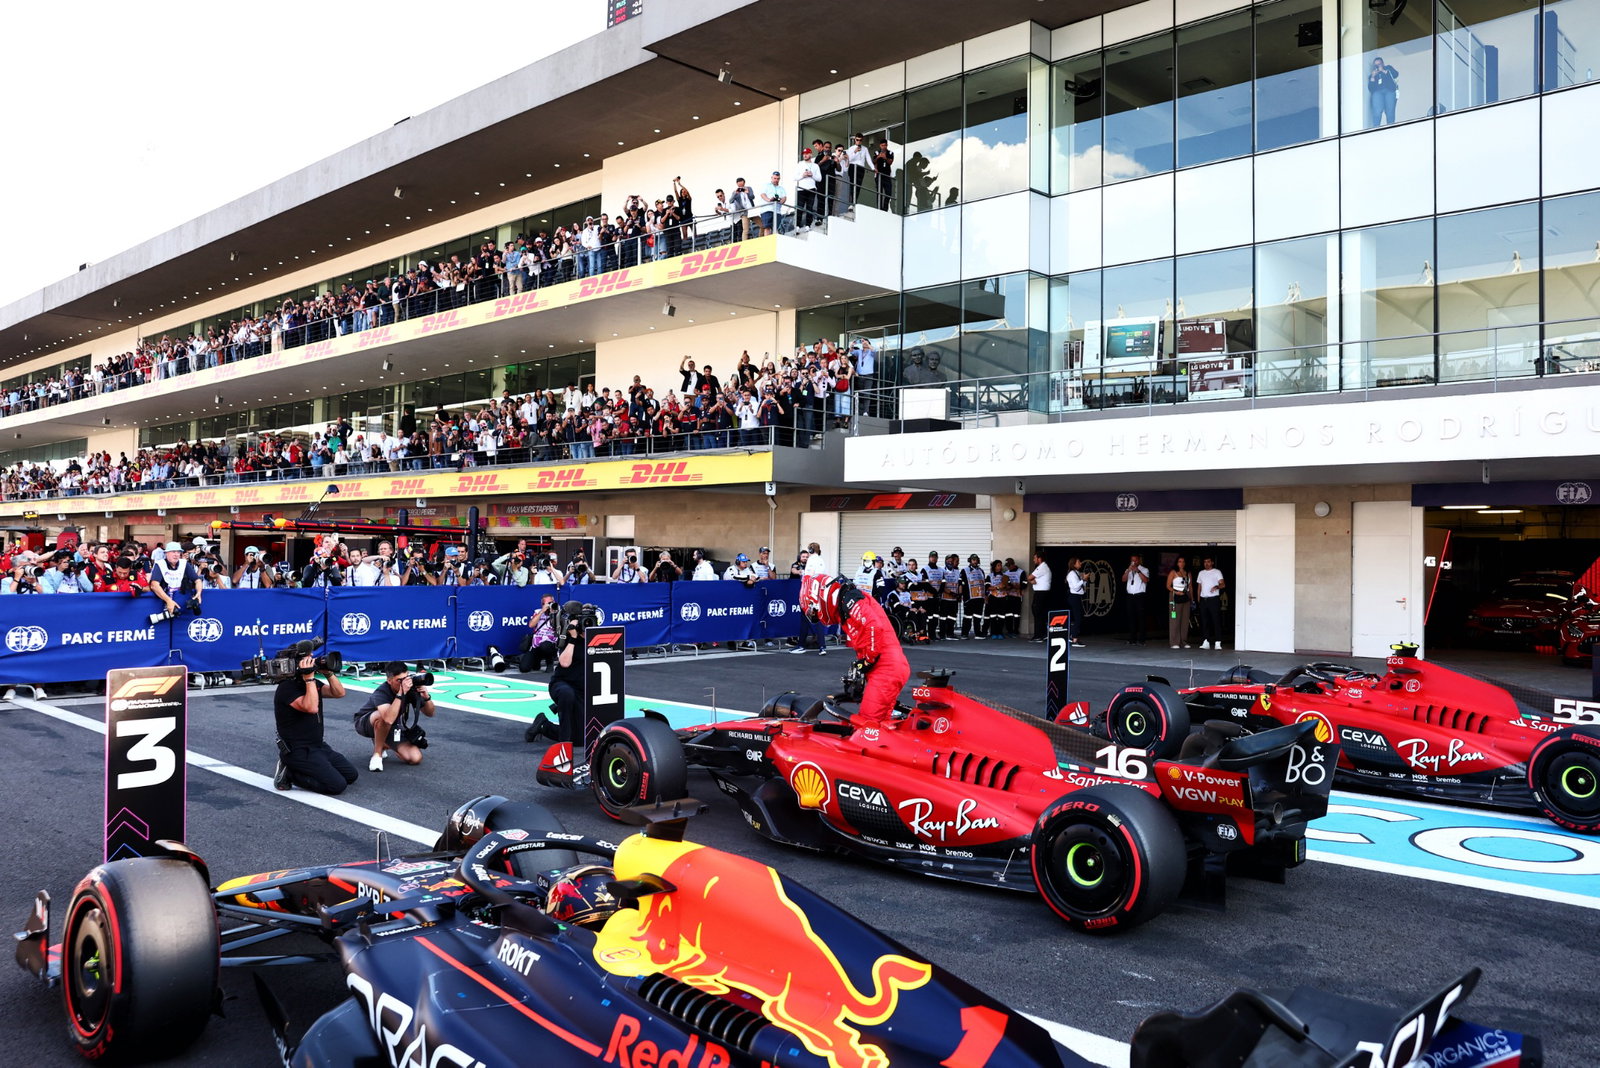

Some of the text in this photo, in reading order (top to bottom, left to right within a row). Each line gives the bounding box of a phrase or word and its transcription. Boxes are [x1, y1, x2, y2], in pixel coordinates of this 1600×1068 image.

[680, 245, 746, 277] DHL
[579, 270, 632, 298] DHL
[494, 292, 539, 317] DHL
[421, 310, 460, 333] DHL
[359, 327, 392, 348] DHL
[304, 341, 334, 360] DHL
[881, 440, 1084, 467] AUTÓDROMO
[1109, 424, 1334, 456] HERMANOS
[536, 468, 588, 490] DHL
[630, 462, 690, 484] DHL
[390, 479, 427, 496] DHL
[457, 474, 500, 493] DHL
[1018, 481, 1023, 490] 2
[235, 489, 260, 503] DHL
[280, 486, 312, 501] DHL
[865, 494, 912, 509] F1
[1557, 485, 1589, 502] FIA
[507, 504, 559, 514] MAX VERSTAPPEN
[1116, 496, 1137, 509] FIA
[612, 612, 636, 622] PARC
[636, 607, 664, 620] FERMÉ
[681, 603, 754, 619] FIA PARC FERMÉ
[768, 602, 786, 616] FIA
[189, 619, 313, 639] FIA PARC FERMÉ
[342, 615, 447, 632] FIA PARC FERMÉ
[468, 613, 528, 629] FIA PARC
[1050, 615, 1068, 626] F1
[7, 626, 156, 649] FIA PARC FERMÉ
[587, 633, 623, 647] F1
[1050, 637, 1067, 672] 2
[1387, 657, 1404, 665] ZCG
[111, 676, 182, 699] F1
[592, 661, 618, 706] 1
[912, 687, 931, 697] ZCG
[1348, 687, 1363, 697] aws
[1553, 698, 1600, 725] 55
[728, 731, 771, 743] RICHARD MILLE
[864, 727, 880, 738] aws
[1341, 728, 1387, 747] CEVA
[116, 716, 176, 790] 3
[1360, 743, 1387, 752] LOGISTICS
[1094, 744, 1148, 780] 16
[1184, 770, 1241, 788] V-Power
[1435, 776, 1461, 784] brembo
[838, 783, 888, 807] CEVA
[1171, 785, 1245, 808] VGW PLAY
[858, 802, 888, 814] LOGISTICS
[1051, 801, 1100, 818] ZERO
[545, 831, 585, 841] telcel
[1217, 824, 1236, 840] FIA
[475, 840, 499, 859] ORACLE
[506, 842, 546, 854] POKERSTARS
[945, 848, 974, 858] brembo
[497, 938, 541, 977] ROKT
[603, 1013, 699, 1068] Red
